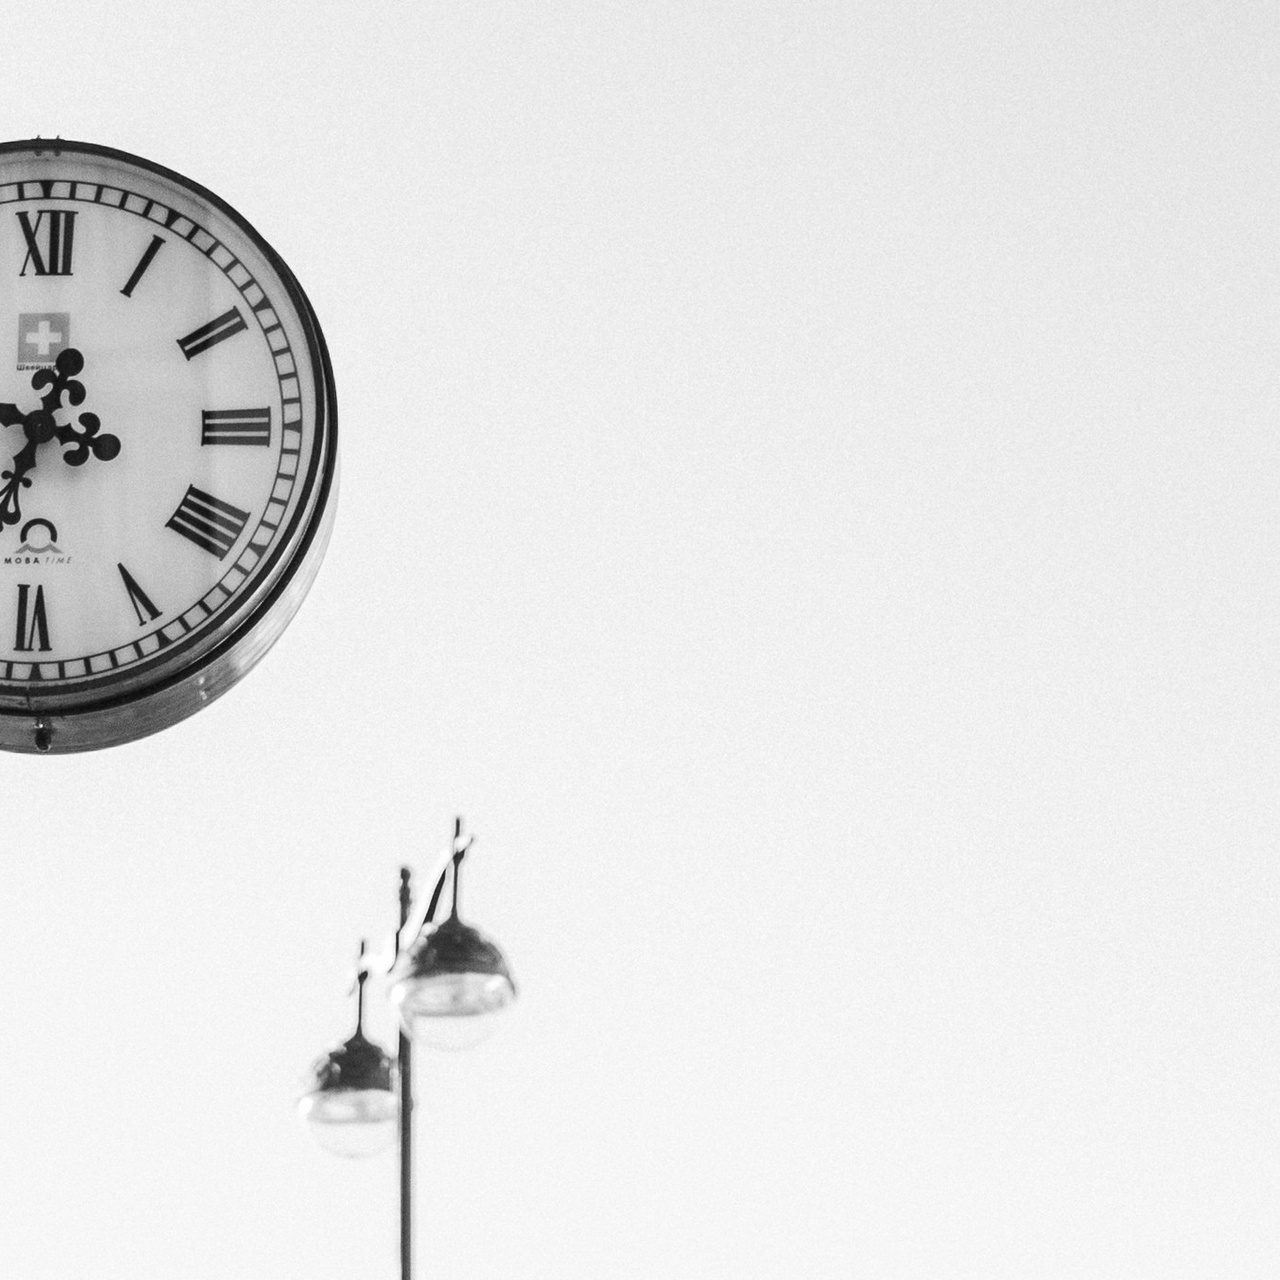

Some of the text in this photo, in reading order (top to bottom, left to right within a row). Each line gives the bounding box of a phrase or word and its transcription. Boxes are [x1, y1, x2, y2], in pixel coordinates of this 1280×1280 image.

[16, 210, 78, 276] XII
[120, 234, 166, 297] I
[177, 306, 248, 361] II
[201, 406, 271, 447] III
[165, 485, 251, 561] IIII
[45, 556, 72, 564] TIME
[14, 584, 52, 652] VI
[117, 562, 163, 626] V
